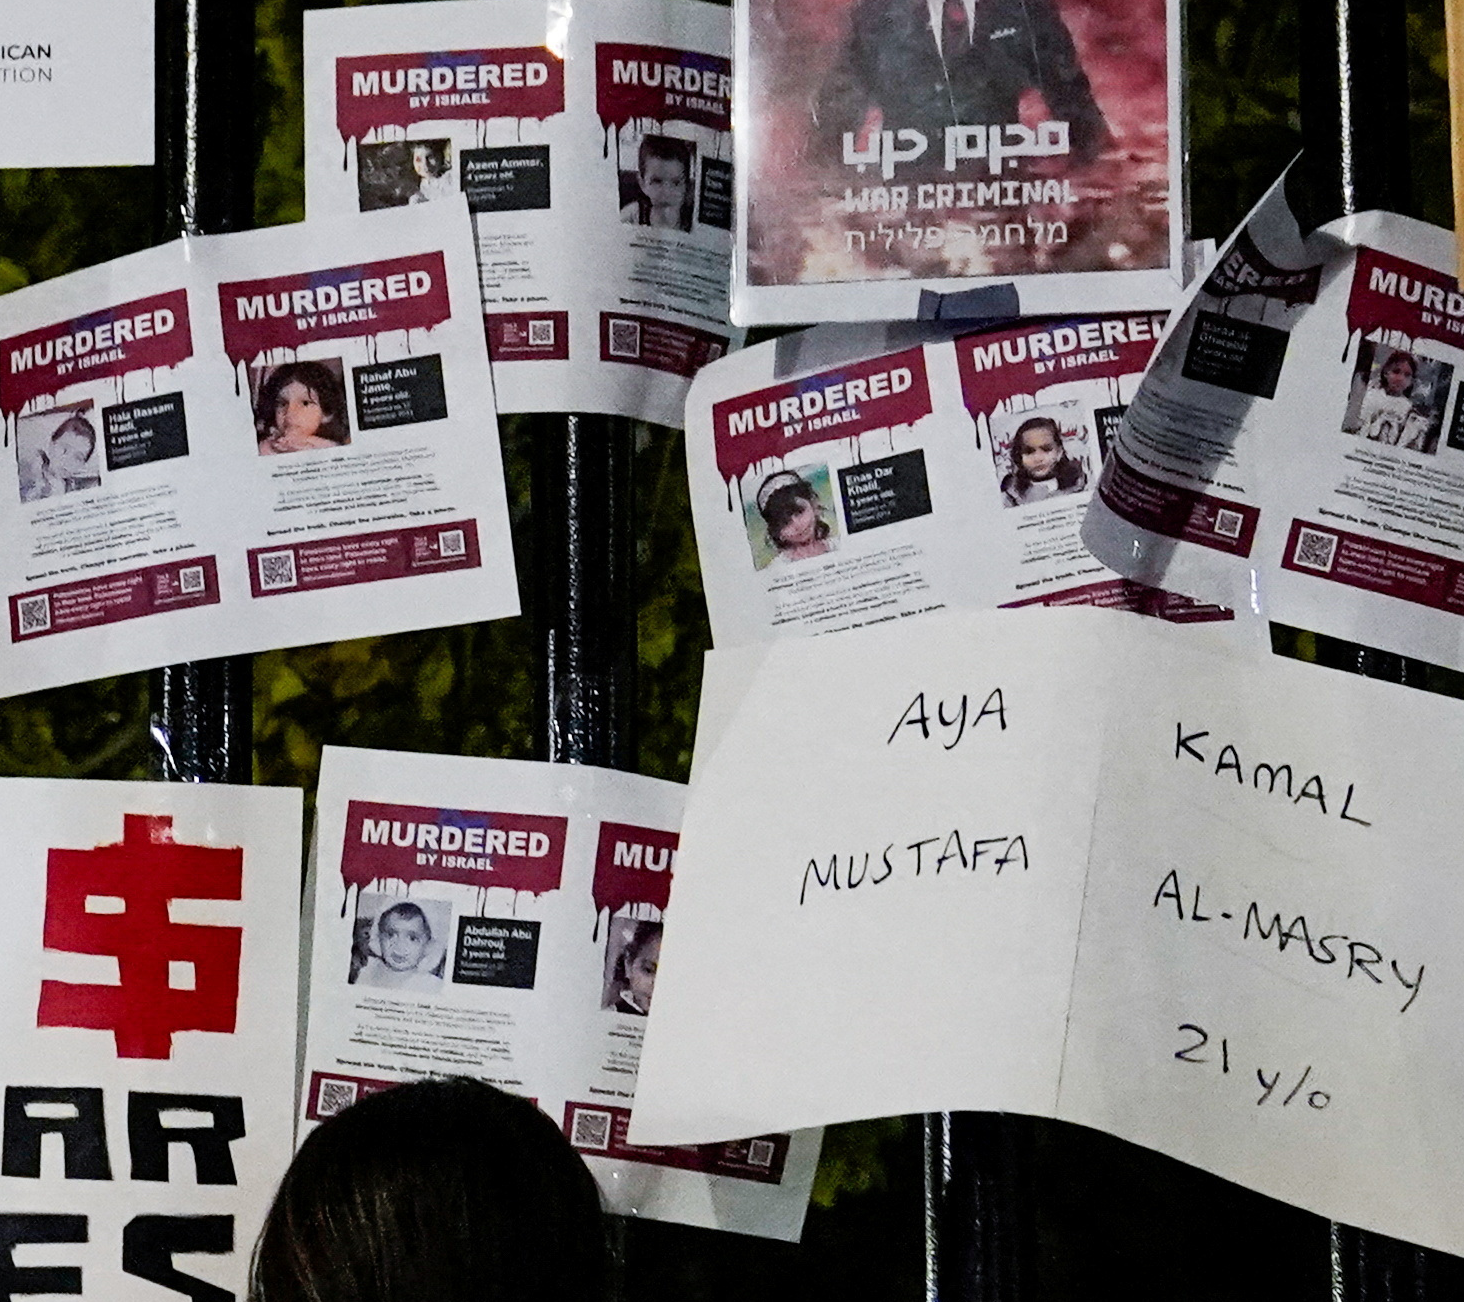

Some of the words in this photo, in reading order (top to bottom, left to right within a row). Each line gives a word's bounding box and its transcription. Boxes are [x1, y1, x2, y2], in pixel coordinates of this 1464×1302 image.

[351, 61, 549, 97] MURDERED
[612, 58, 732, 99] MURDER
[408, 95, 431, 109] BY
[434, 92, 491, 107] ISRAEL
[665, 92, 683, 107] BY
[686, 96, 726, 116] ISRAEL
[843, 185, 910, 213] WAR
[917, 178, 1080, 211] CRIMINAL
[235, 270, 432, 321] MURDERED
[295, 314, 319, 331] BY
[321, 306, 378, 328] ISRAEL
[1420, 311, 1444, 326] BY
[9, 307, 176, 375] MURDERED
[55, 361, 75, 376] BY
[77, 346, 127, 370] ISRAEL
[1033, 360, 1058, 375] BY
[1061, 349, 1120, 370] ISRAEL
[727, 367, 913, 438] MURDERED
[783, 422, 806, 438] BY
[807, 408, 862, 431] ISRAEL
[360, 818, 551, 858] MURDERED
[416, 851, 439, 866] BY
[441, 855, 494, 872] ISRAEL
[800, 829, 1030, 906] MUSTAFA
[36, 811, 244, 1060] $
[511, 926, 533, 940] Abu
[1154, 868, 1426, 1013] AL-MASRY
[1173, 1022, 1230, 1073] 21
